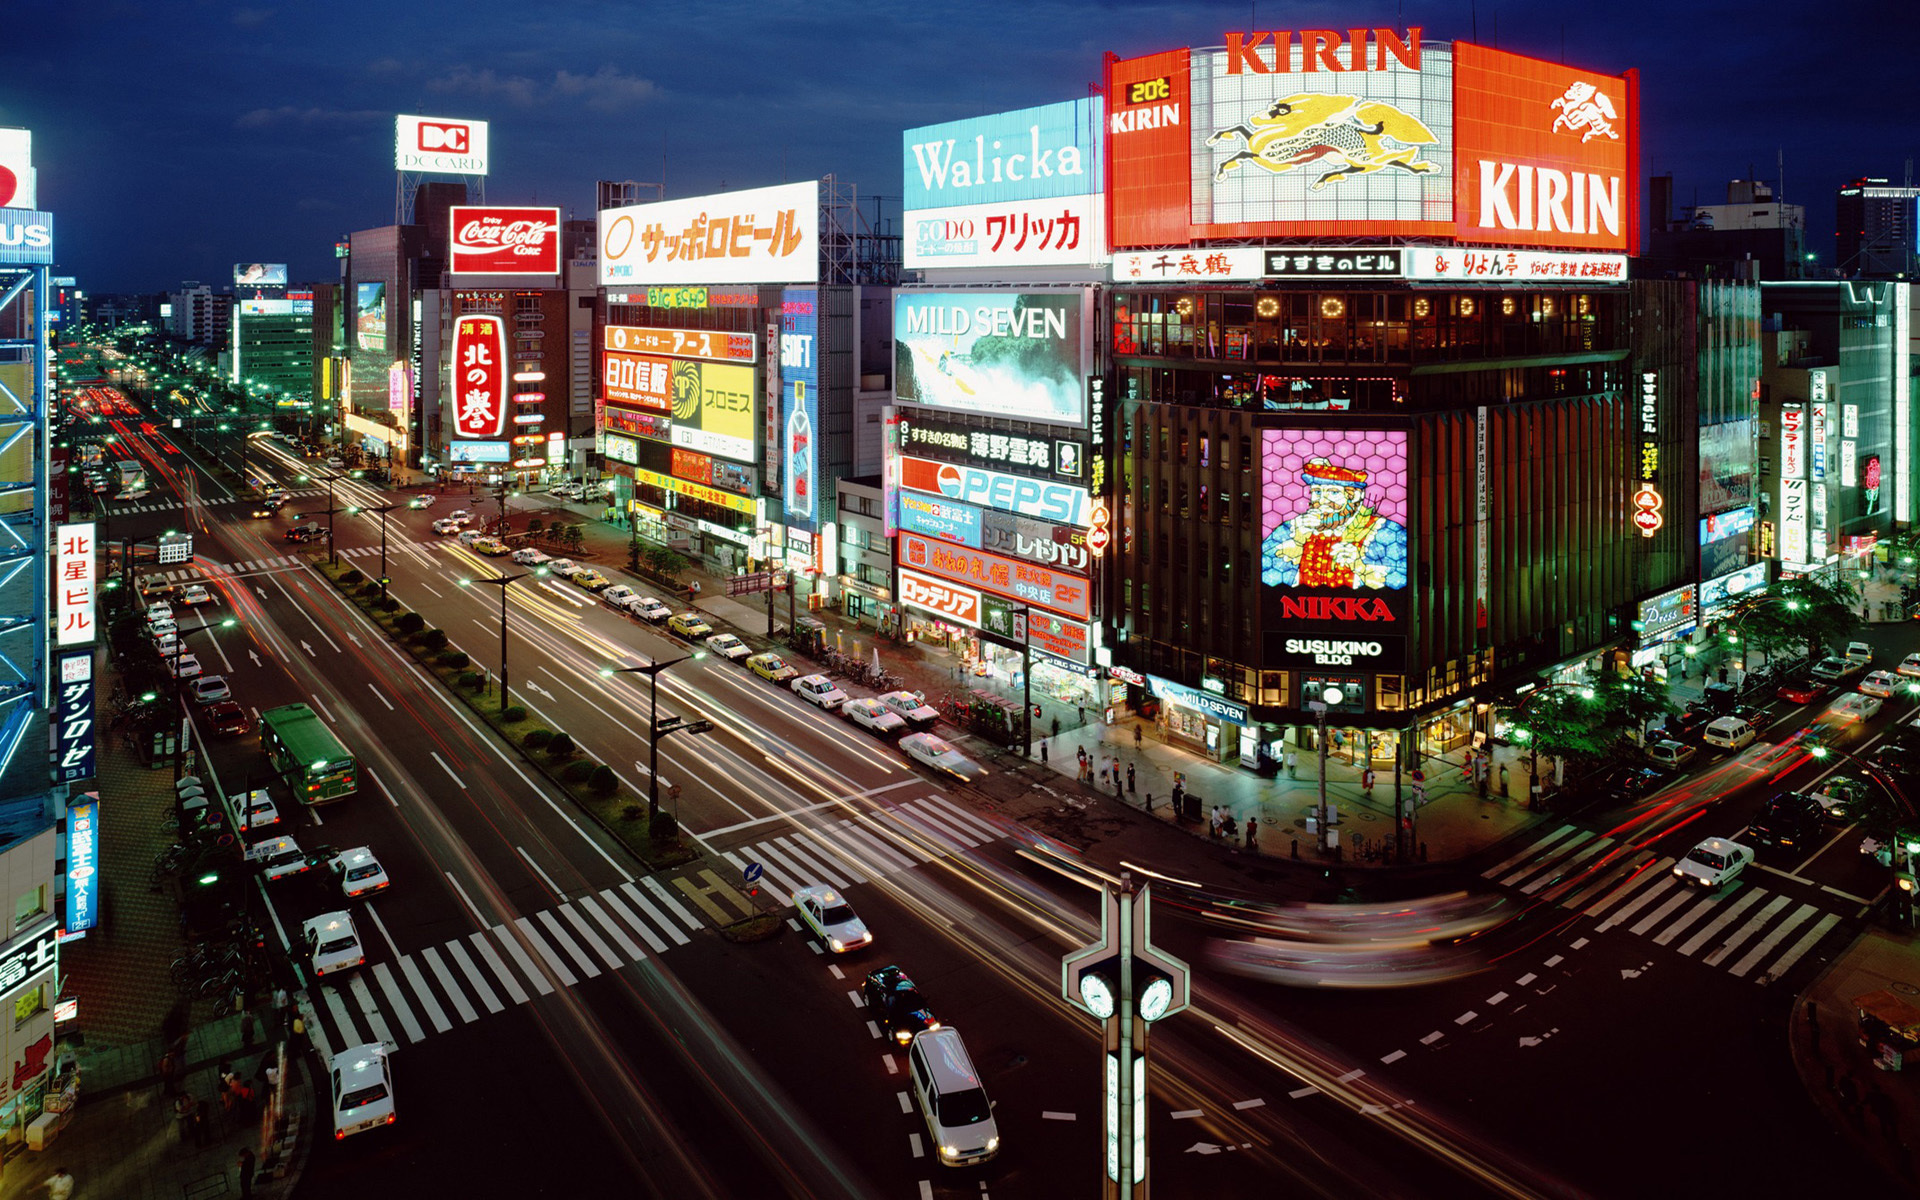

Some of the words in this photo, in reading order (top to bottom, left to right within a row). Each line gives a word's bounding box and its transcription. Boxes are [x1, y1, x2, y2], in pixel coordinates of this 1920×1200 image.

[1225, 27, 1421, 75] KIRIN
[1111, 103, 1180, 135] KIRIN
[404, 155, 430, 167] DC
[435, 156, 483, 170] CARD
[911, 125, 1083, 191] Walicka
[1477, 160, 1620, 237] KIRIN
[459, 221, 546, 245] Coca-Cola
[641, 209, 802, 263] サッポロビール
[917, 219, 974, 241] GODO
[986, 210, 1080, 252] ワリッカ
[513, 245, 542, 256] Coke
[1152, 252, 1233, 275] 千歳鶴
[1271, 255, 1395, 271] すすきのビル
[1435, 255, 1450, 273] 8F
[675, 288, 706, 309] ECHO
[462, 323, 492, 335] 清酒
[785, 317, 795, 331] Hi
[907, 305, 971, 336] MILD
[975, 306, 1066, 339] SEVEN
[673, 332, 712, 356] アース
[781, 335, 813, 368] SOFT
[606, 358, 668, 395] 日立信販
[705, 389, 751, 414] プロミス
[1092, 379, 1103, 444] すすきのビル
[1785, 410, 1802, 442] ゼブラ
[911, 428, 968, 450] すすきの名物店
[961, 470, 1084, 524] PEPSI
[1786, 496, 1804, 521] ワイド
[1070, 533, 1087, 545] 5F
[63, 536, 90, 631] 北星ビル
[1015, 583, 1051, 604] 中央店
[1055, 584, 1081, 605] 2F
[902, 578, 975, 616] ロッテリア
[1280, 595, 1396, 622] NIKKA
[1645, 605, 1678, 626] Dress
[1285, 639, 1383, 656] SUSUKINO
[1315, 654, 1352, 665] BLDG
[1183, 692, 1208, 708] MILD
[1210, 702, 1244, 721] SEVEN
[61, 684, 92, 768] サンローゼ
[65, 767, 87, 779] B1
